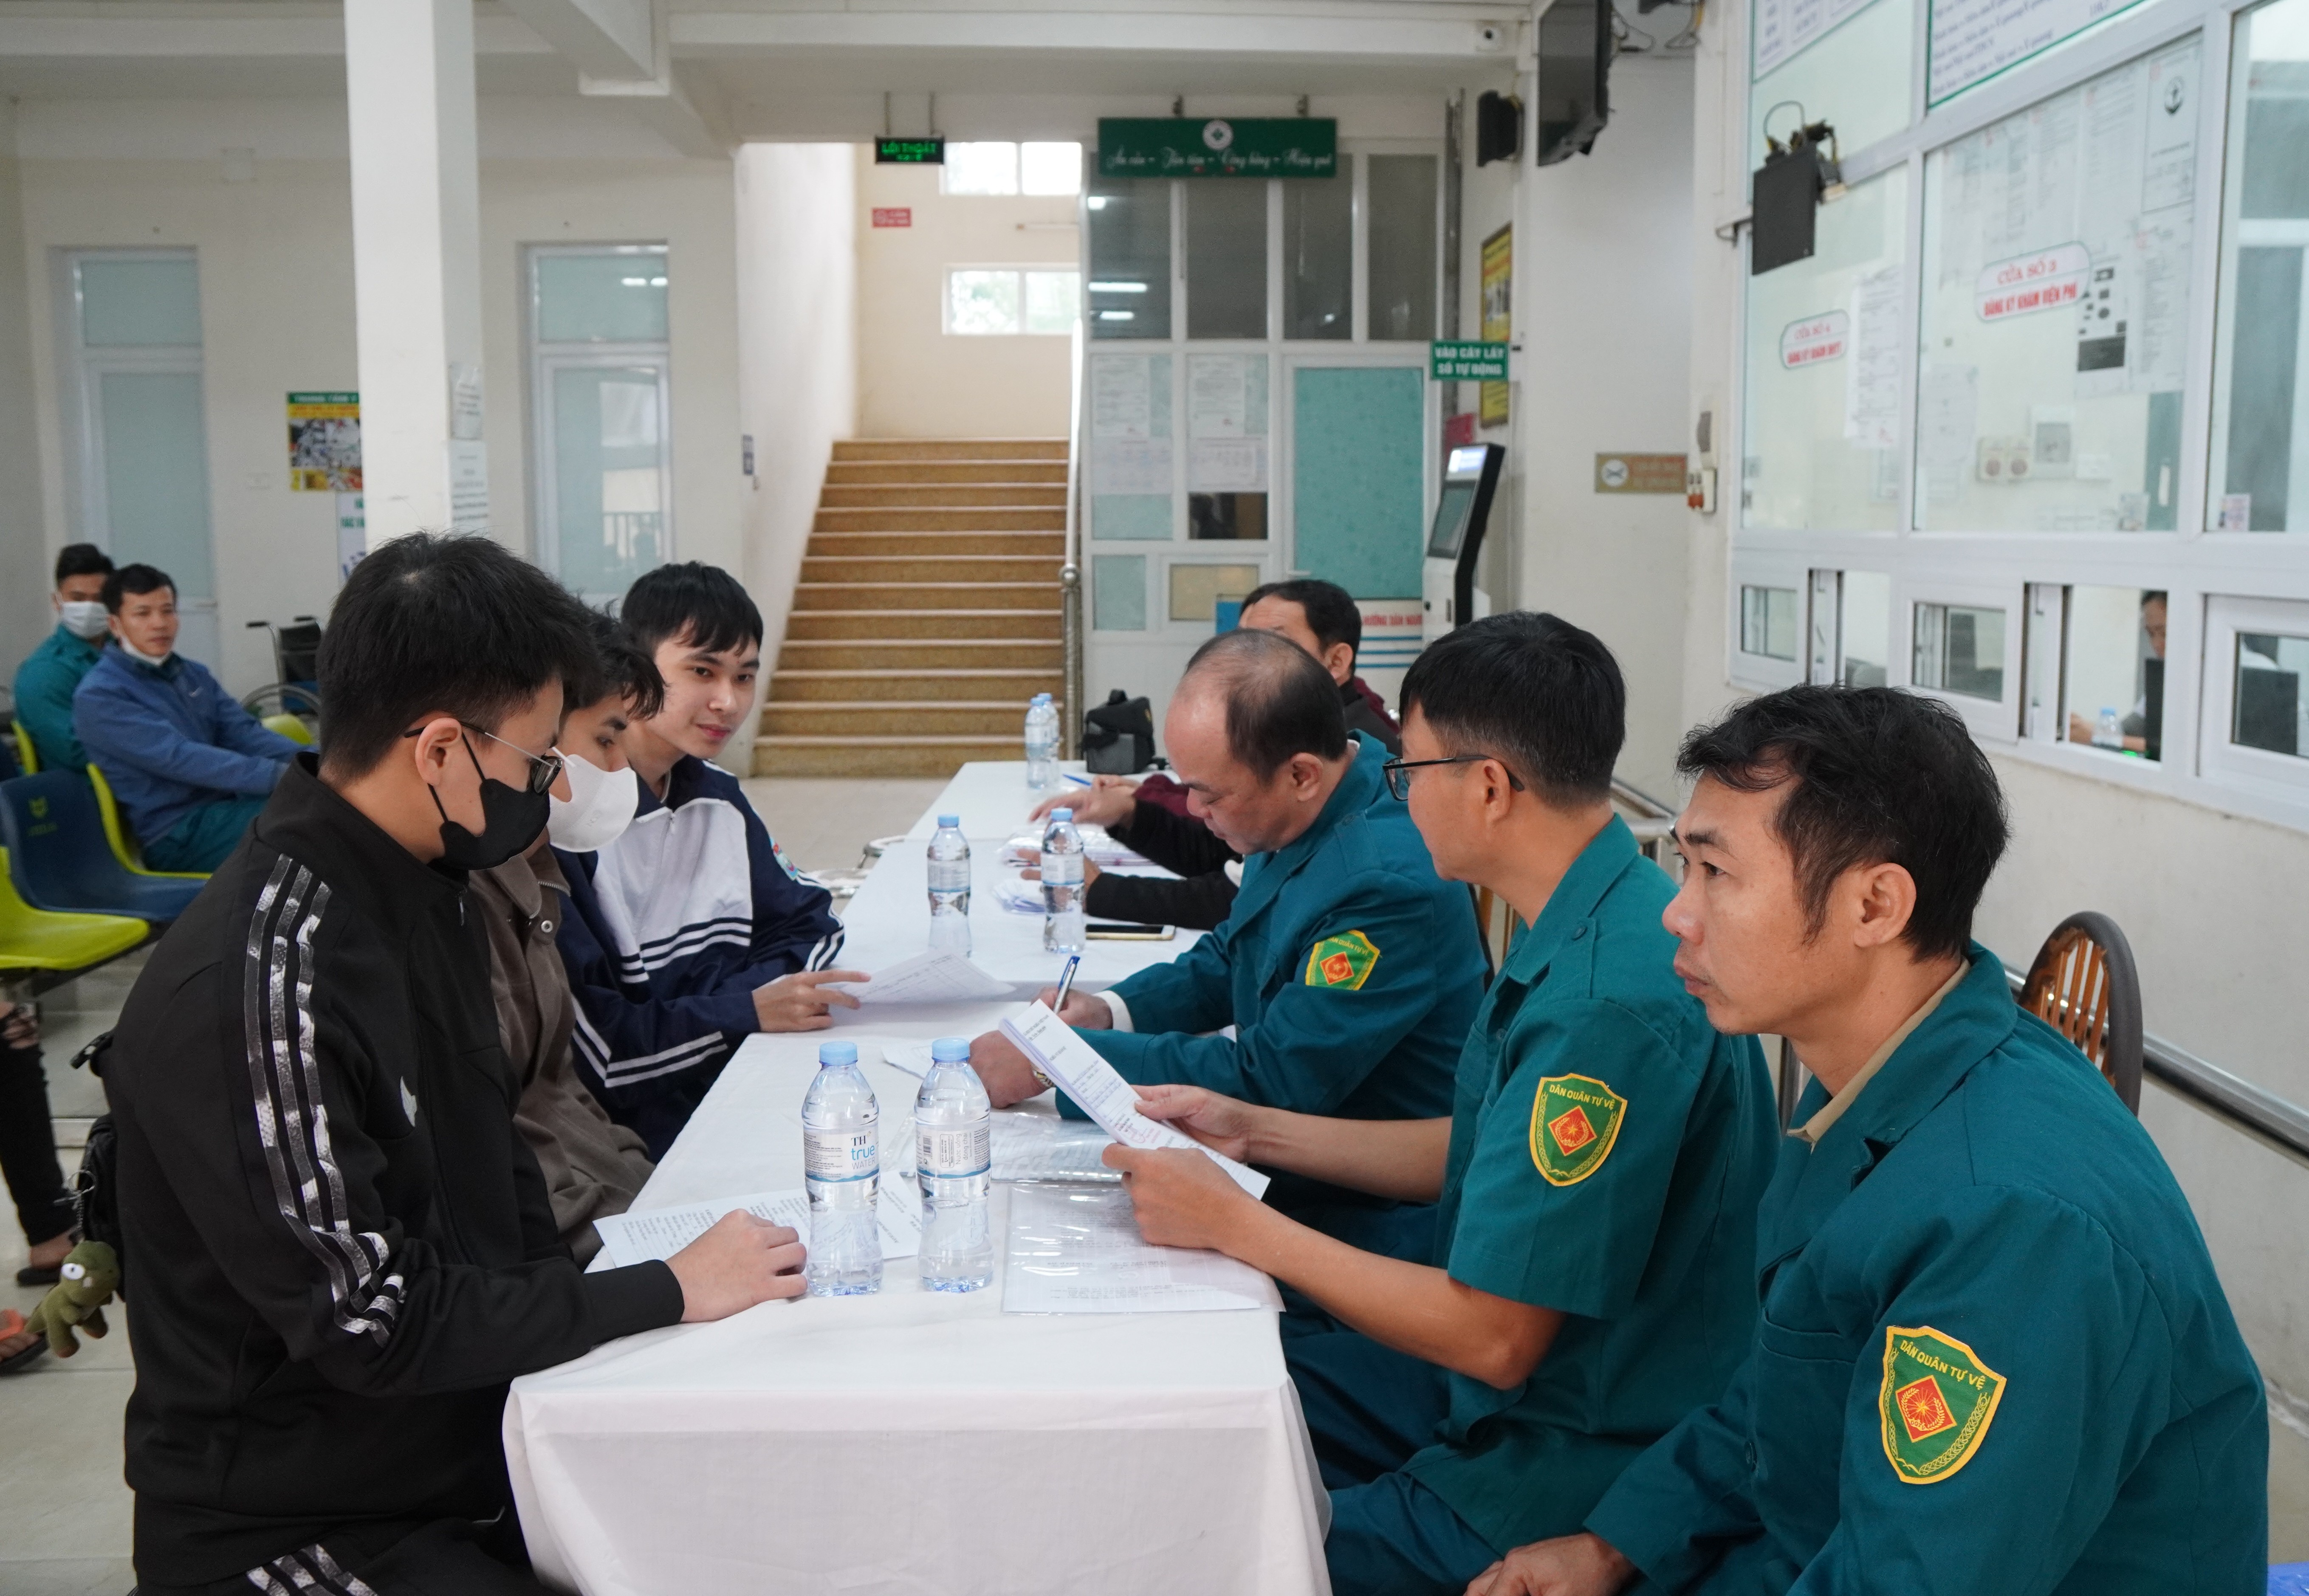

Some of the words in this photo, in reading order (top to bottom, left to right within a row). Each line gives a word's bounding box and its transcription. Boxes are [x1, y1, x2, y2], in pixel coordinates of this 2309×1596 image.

[1998, 263, 2023, 284] CỬA
[1983, 298, 2003, 316] ĐĂNG
[2018, 290, 2039, 309] KHÁM
[1435, 345, 1458, 359] VÀO
[1459, 345, 1481, 359] CÂY
[1437, 361, 1453, 375] SỐ
[1471, 361, 1503, 376] ĐỘNG
[1550, 1084, 1567, 1097] DÂN
[1567, 1090, 1590, 1103] QUÂN
[1592, 1095, 1604, 1107] TỰ
[1605, 1098, 1615, 1110] VỆ
[851, 1135, 866, 1146] TH
[851, 1145, 875, 1160] true
[852, 1156, 875, 1170] WATER
[1900, 1340, 1919, 1358] DÂN
[1916, 1352, 1948, 1374] QUÂN
[1951, 1365, 1968, 1382] TỰ
[1969, 1373, 1987, 1391] VỆ
